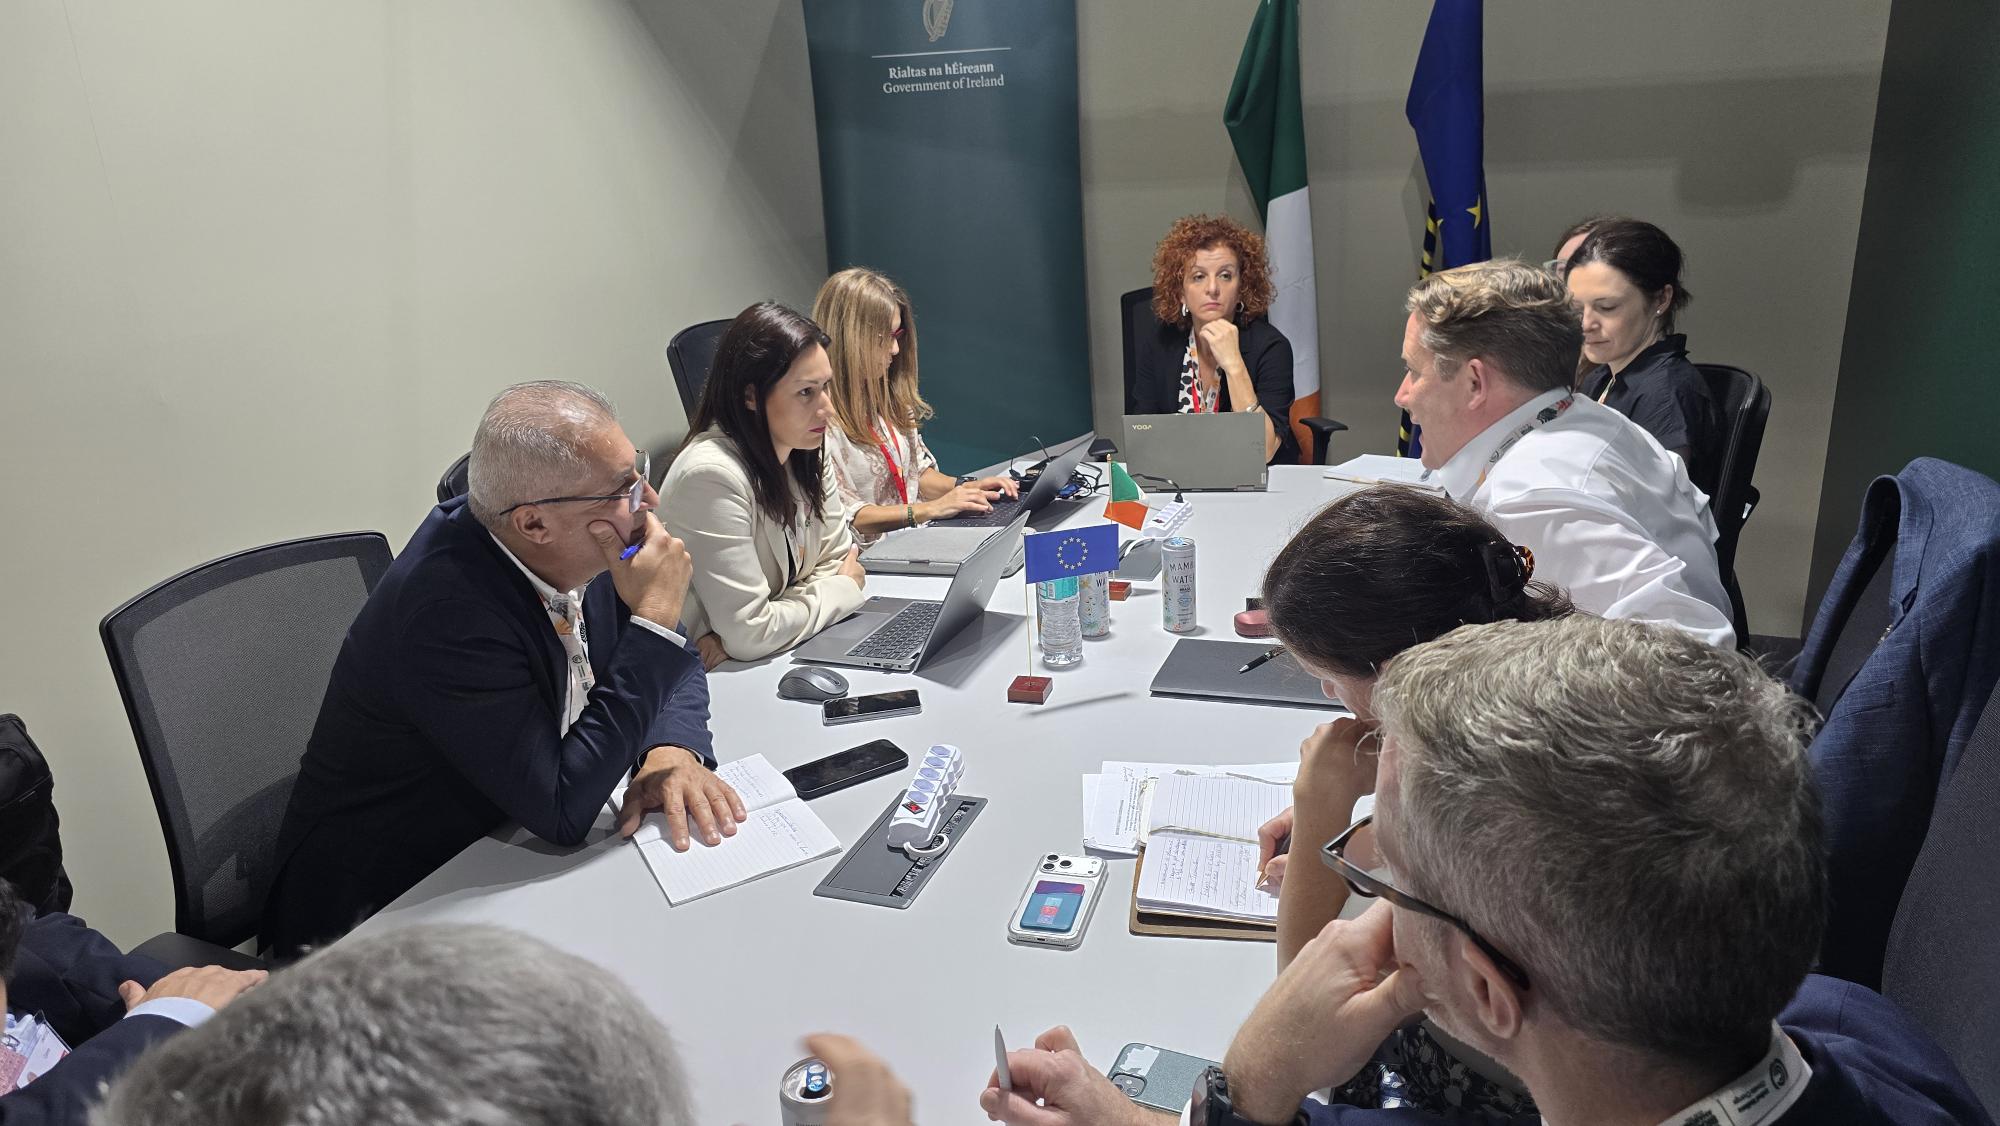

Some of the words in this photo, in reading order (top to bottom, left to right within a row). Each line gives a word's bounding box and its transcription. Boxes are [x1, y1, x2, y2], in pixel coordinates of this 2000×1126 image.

[888, 65, 927, 79] Rialtas
[929, 66, 943, 76] na
[944, 61, 995, 75] hÉireann
[882, 80, 951, 94] Government
[952, 76, 967, 90] of
[966, 73, 1005, 88] Ireland
[1132, 423, 1153, 431] YOGA
